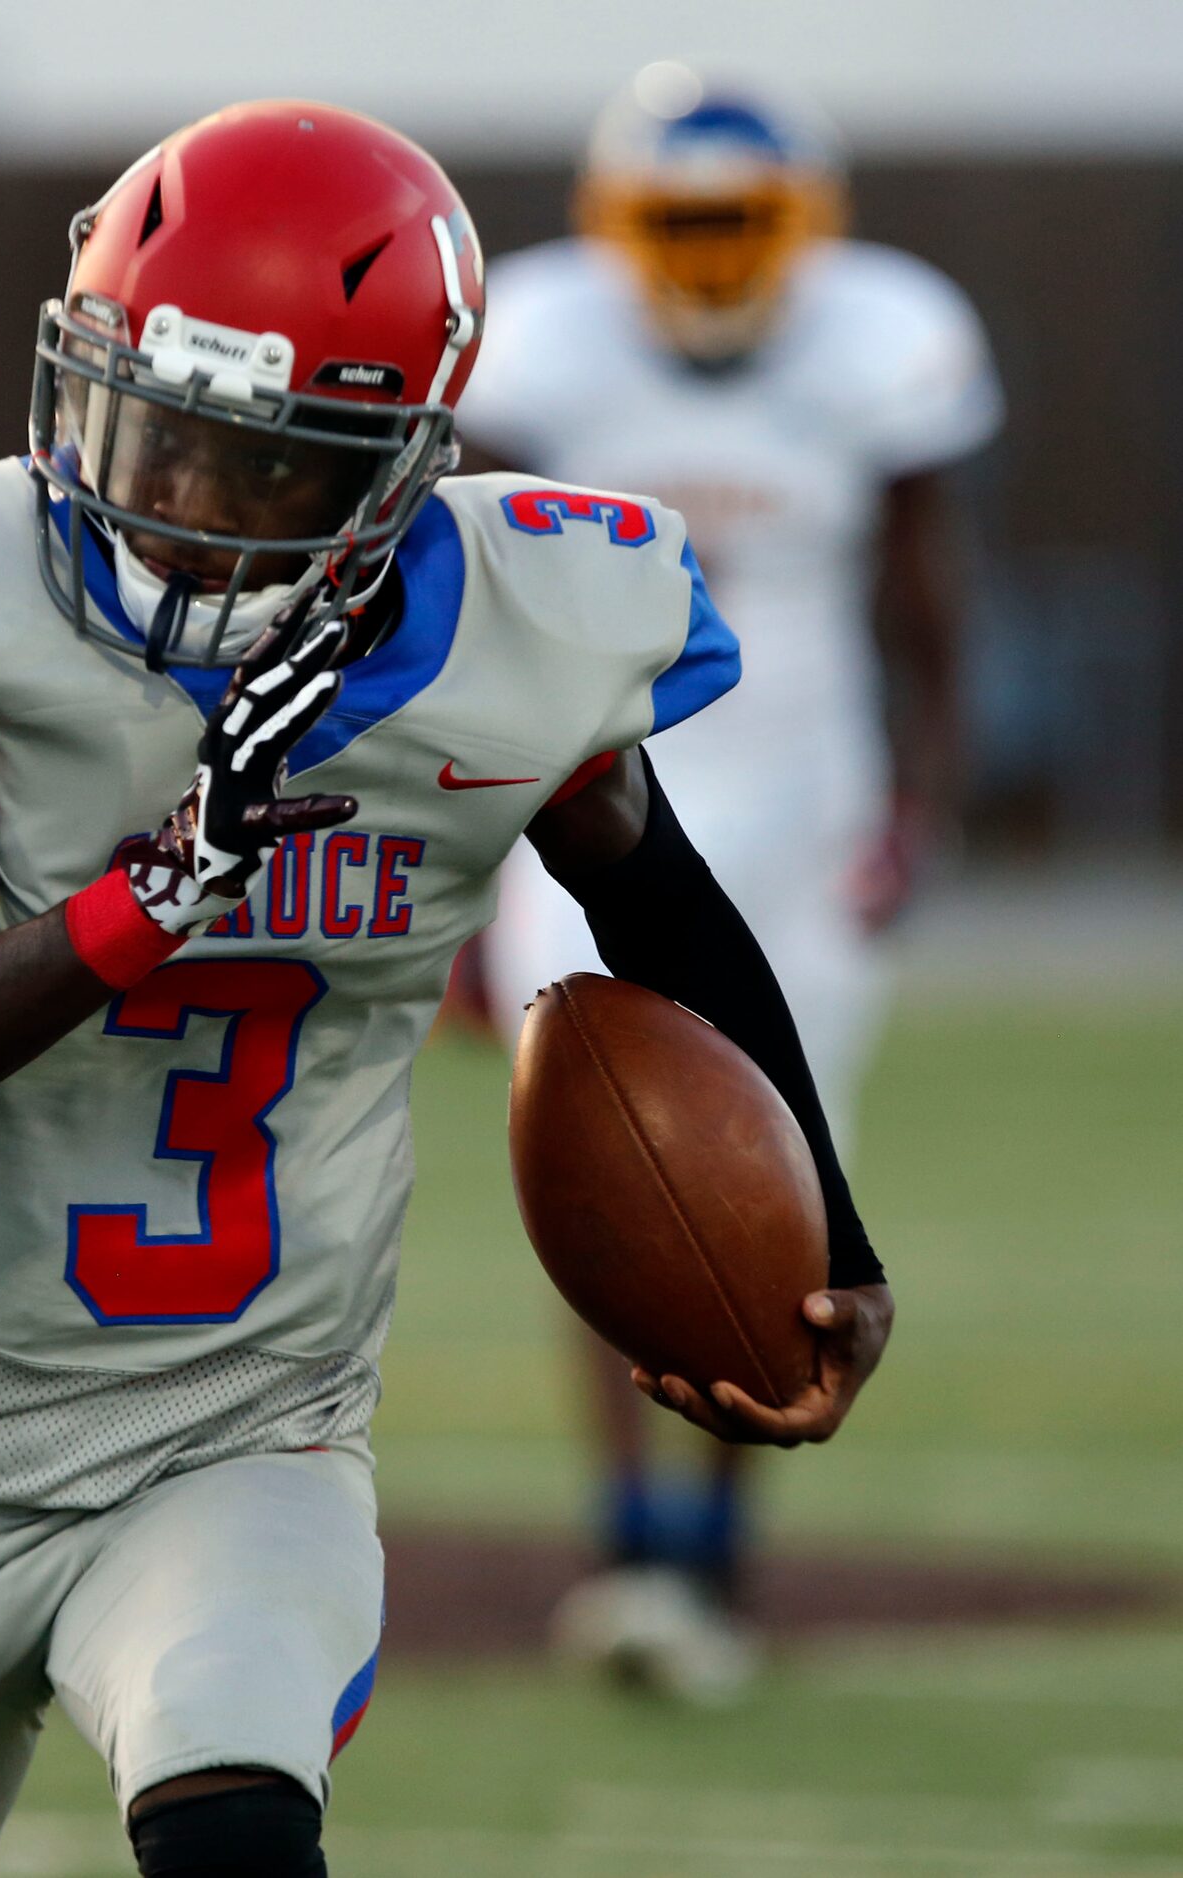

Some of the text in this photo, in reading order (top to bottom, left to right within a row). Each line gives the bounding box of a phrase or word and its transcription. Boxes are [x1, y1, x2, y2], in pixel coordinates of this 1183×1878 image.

[189, 333, 247, 361] schutt
[339, 365, 385, 385] schutt
[498, 490, 657, 548] 3
[105, 831, 426, 939] UCE
[64, 956, 330, 1327] 3
